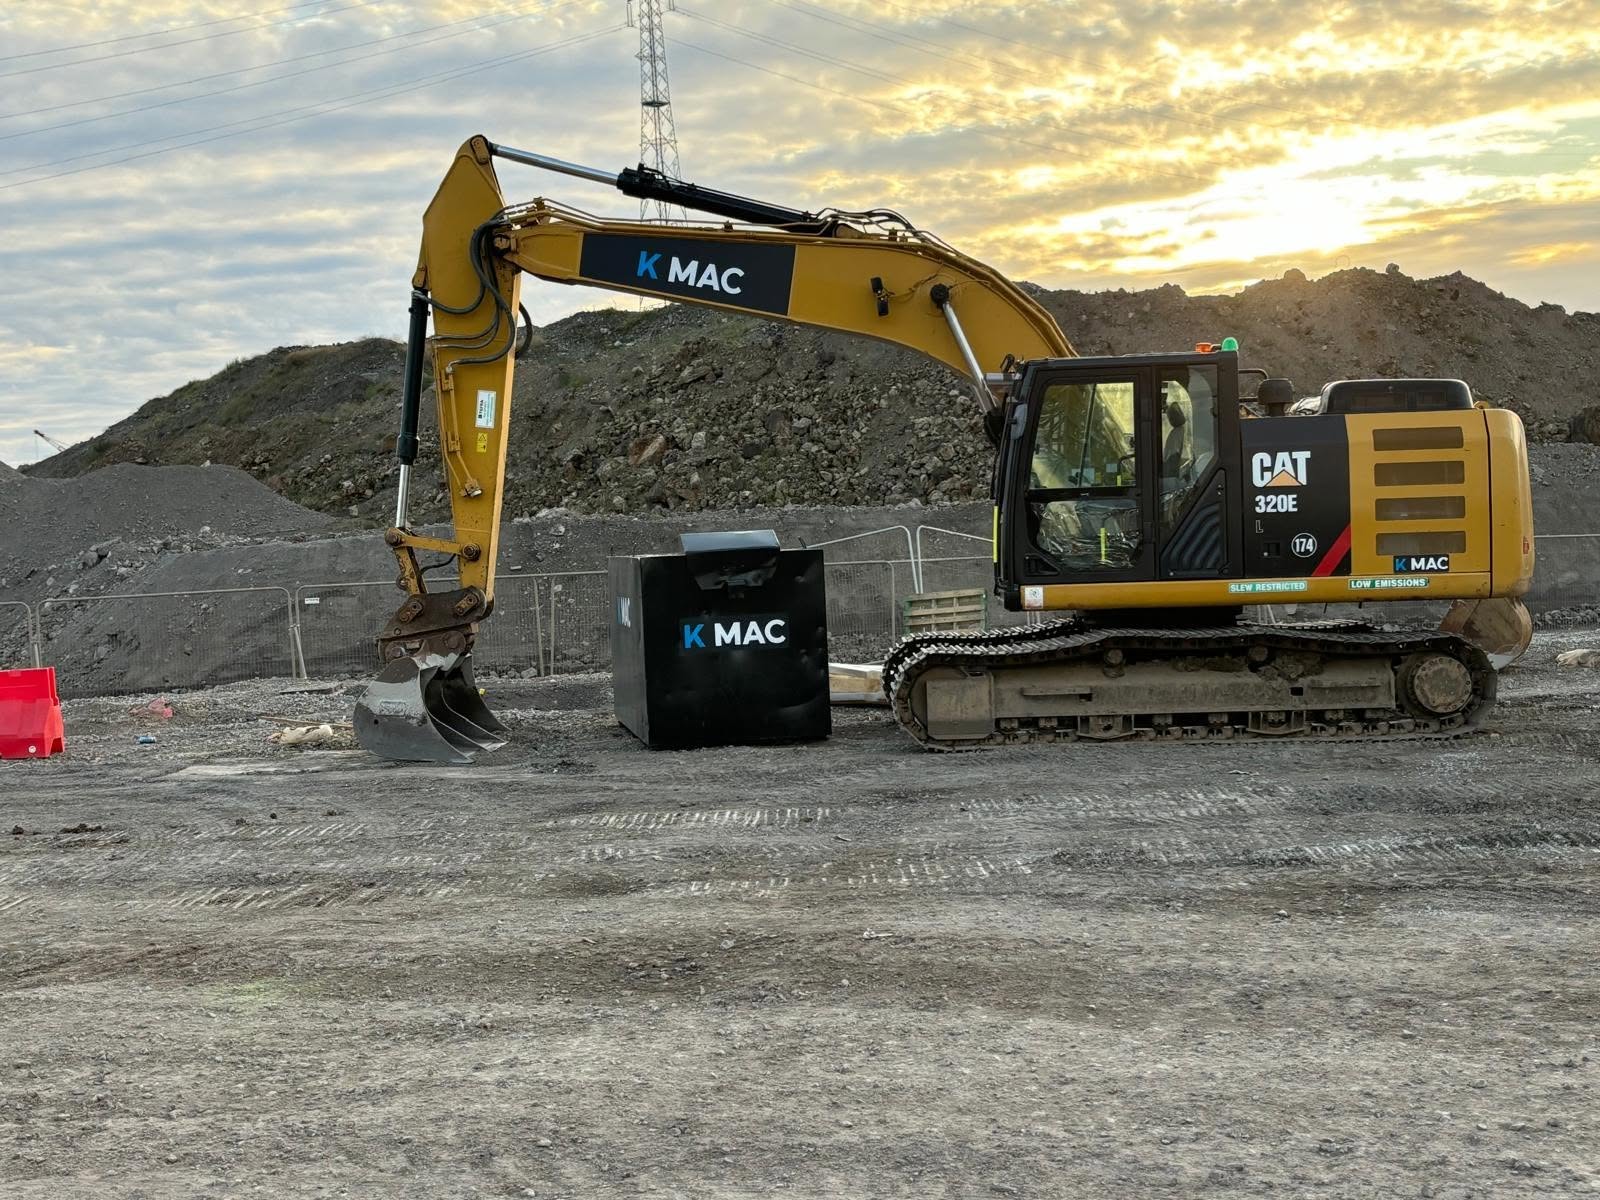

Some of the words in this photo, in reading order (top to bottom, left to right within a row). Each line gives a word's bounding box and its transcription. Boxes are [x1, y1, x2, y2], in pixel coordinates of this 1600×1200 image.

[637, 251, 661, 280] K
[667, 256, 745, 295] MAC
[1252, 451, 1311, 488] CAT
[1255, 494, 1298, 513] 320E
[1255, 520, 1263, 533] L
[1295, 538, 1314, 553] 174
[1395, 558, 1407, 571] K
[1410, 556, 1449, 570] MAC
[1230, 583, 1253, 592] SLEW
[1255, 582, 1305, 592] RESTRICTED
[1351, 580, 1371, 588] LOW
[1375, 578, 1427, 588] EMISSIONS
[683, 623, 706, 649] K
[714, 619, 786, 647] MAC
